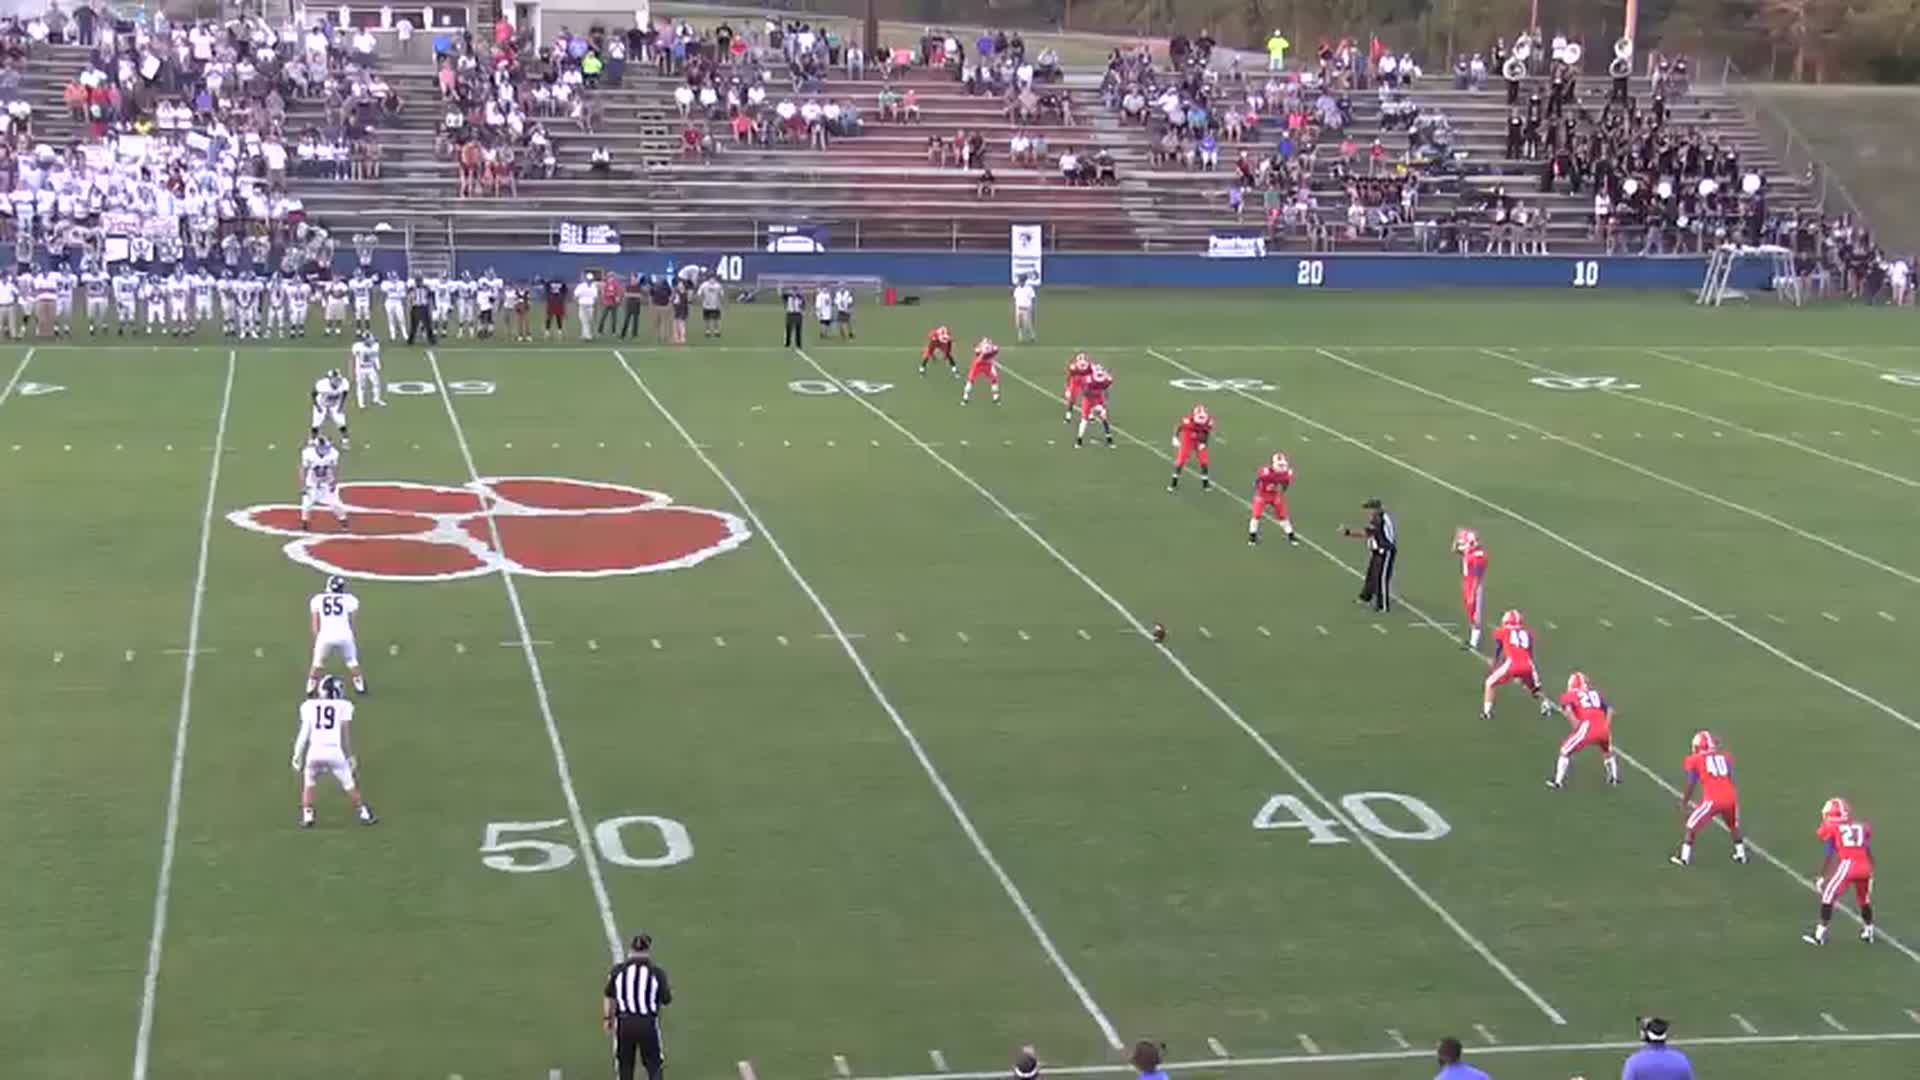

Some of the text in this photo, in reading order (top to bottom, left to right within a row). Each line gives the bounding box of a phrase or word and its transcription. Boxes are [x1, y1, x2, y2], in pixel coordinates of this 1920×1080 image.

[717, 255, 742, 280] 40
[1297, 260, 1323, 284] 20
[1574, 261, 1598, 286] 10
[387, 380, 496, 394] 50
[787, 379, 894, 394] 40
[322, 597, 343, 616] 65
[315, 706, 335, 730] 19
[1706, 755, 1729, 776] 40
[1253, 791, 1451, 844] 40
[480, 815, 695, 873] 50
[1839, 824, 1864, 847] 27
